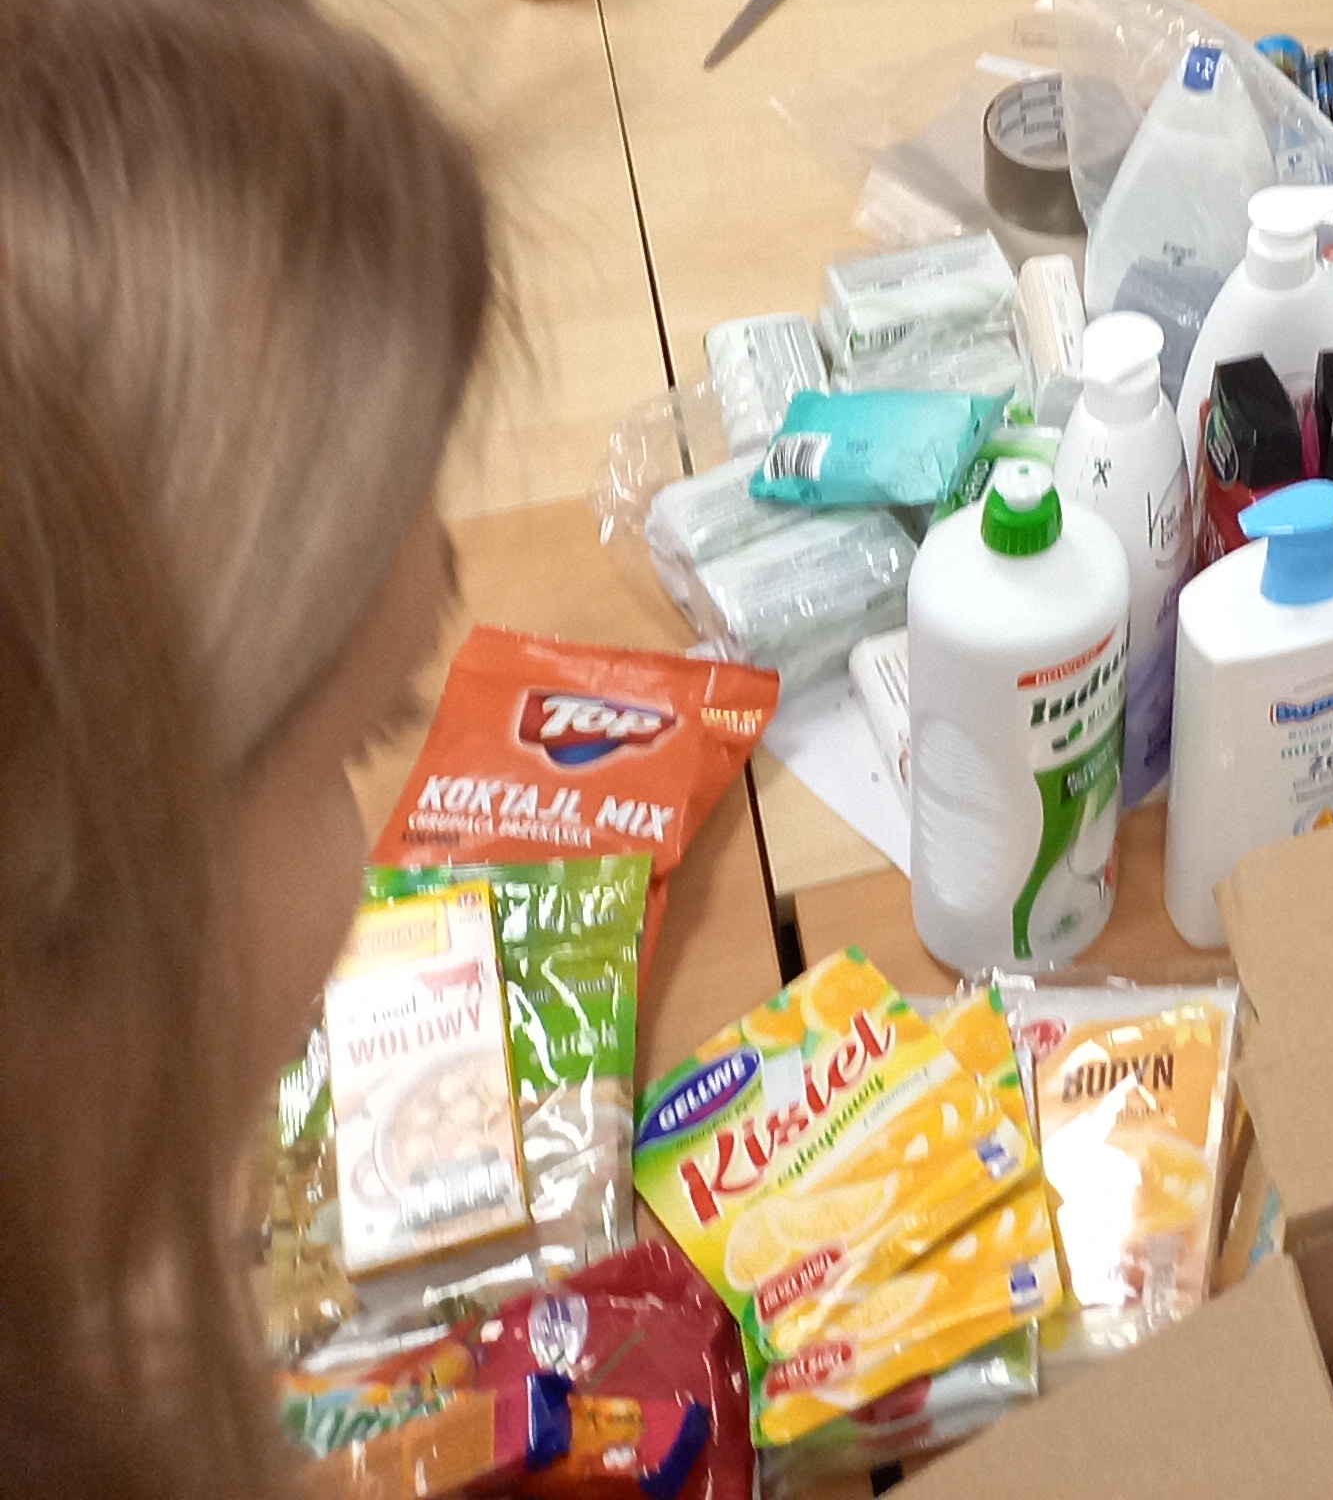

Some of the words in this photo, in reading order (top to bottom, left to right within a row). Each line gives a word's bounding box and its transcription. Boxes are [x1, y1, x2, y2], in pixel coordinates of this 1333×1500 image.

[418, 775, 583, 822] KOKTAJL
[596, 794, 676, 843] MIX
[677, 1009, 896, 1228] Kisiel
